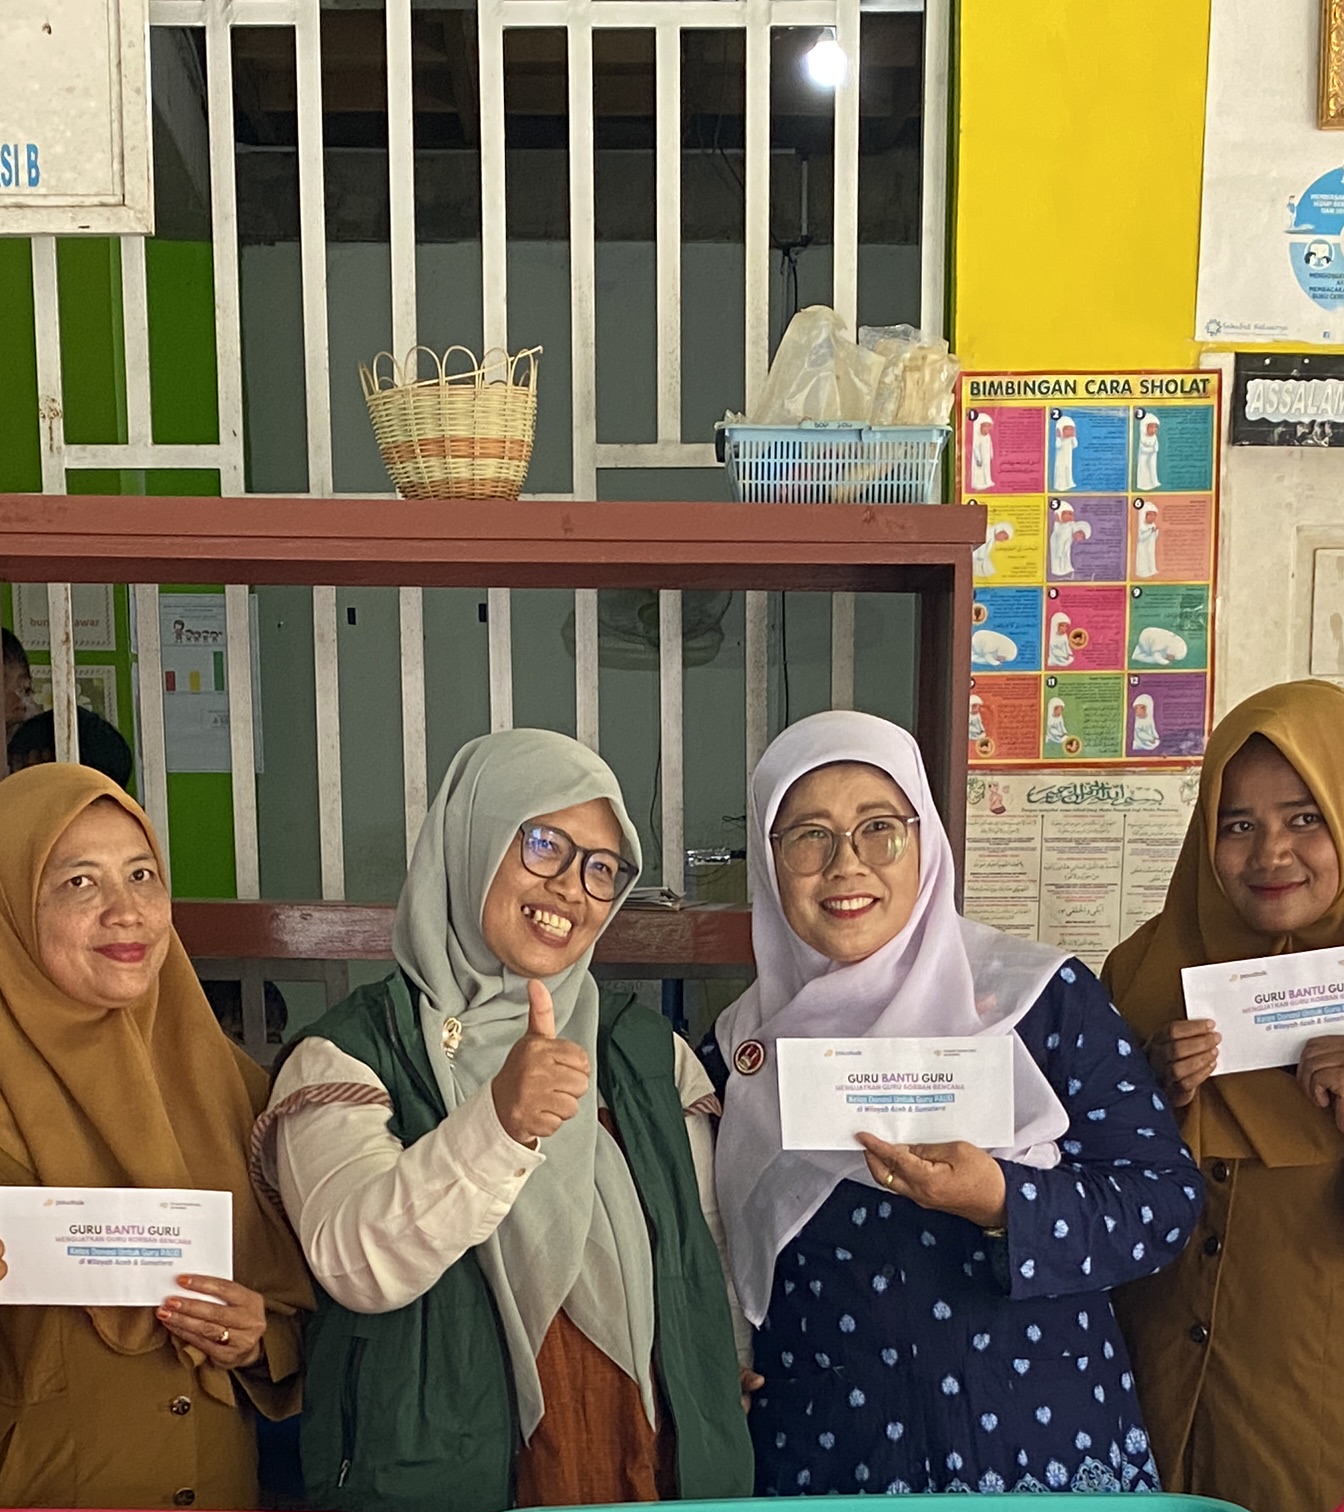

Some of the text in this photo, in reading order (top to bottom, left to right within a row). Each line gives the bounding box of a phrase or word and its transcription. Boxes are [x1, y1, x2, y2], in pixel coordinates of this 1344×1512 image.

[27, 143, 40, 187] B
[970, 378, 1210, 396] BIMBINGAN CARA SHOLAT
[74, 618, 99, 627] awar
[1254, 991, 1287, 1005] GURU
[1288, 985, 1326, 1000] BANTU
[848, 1072, 954, 1084] GURU BANTU GURU
[69, 1225, 181, 1237] GURU BANTU GURU
